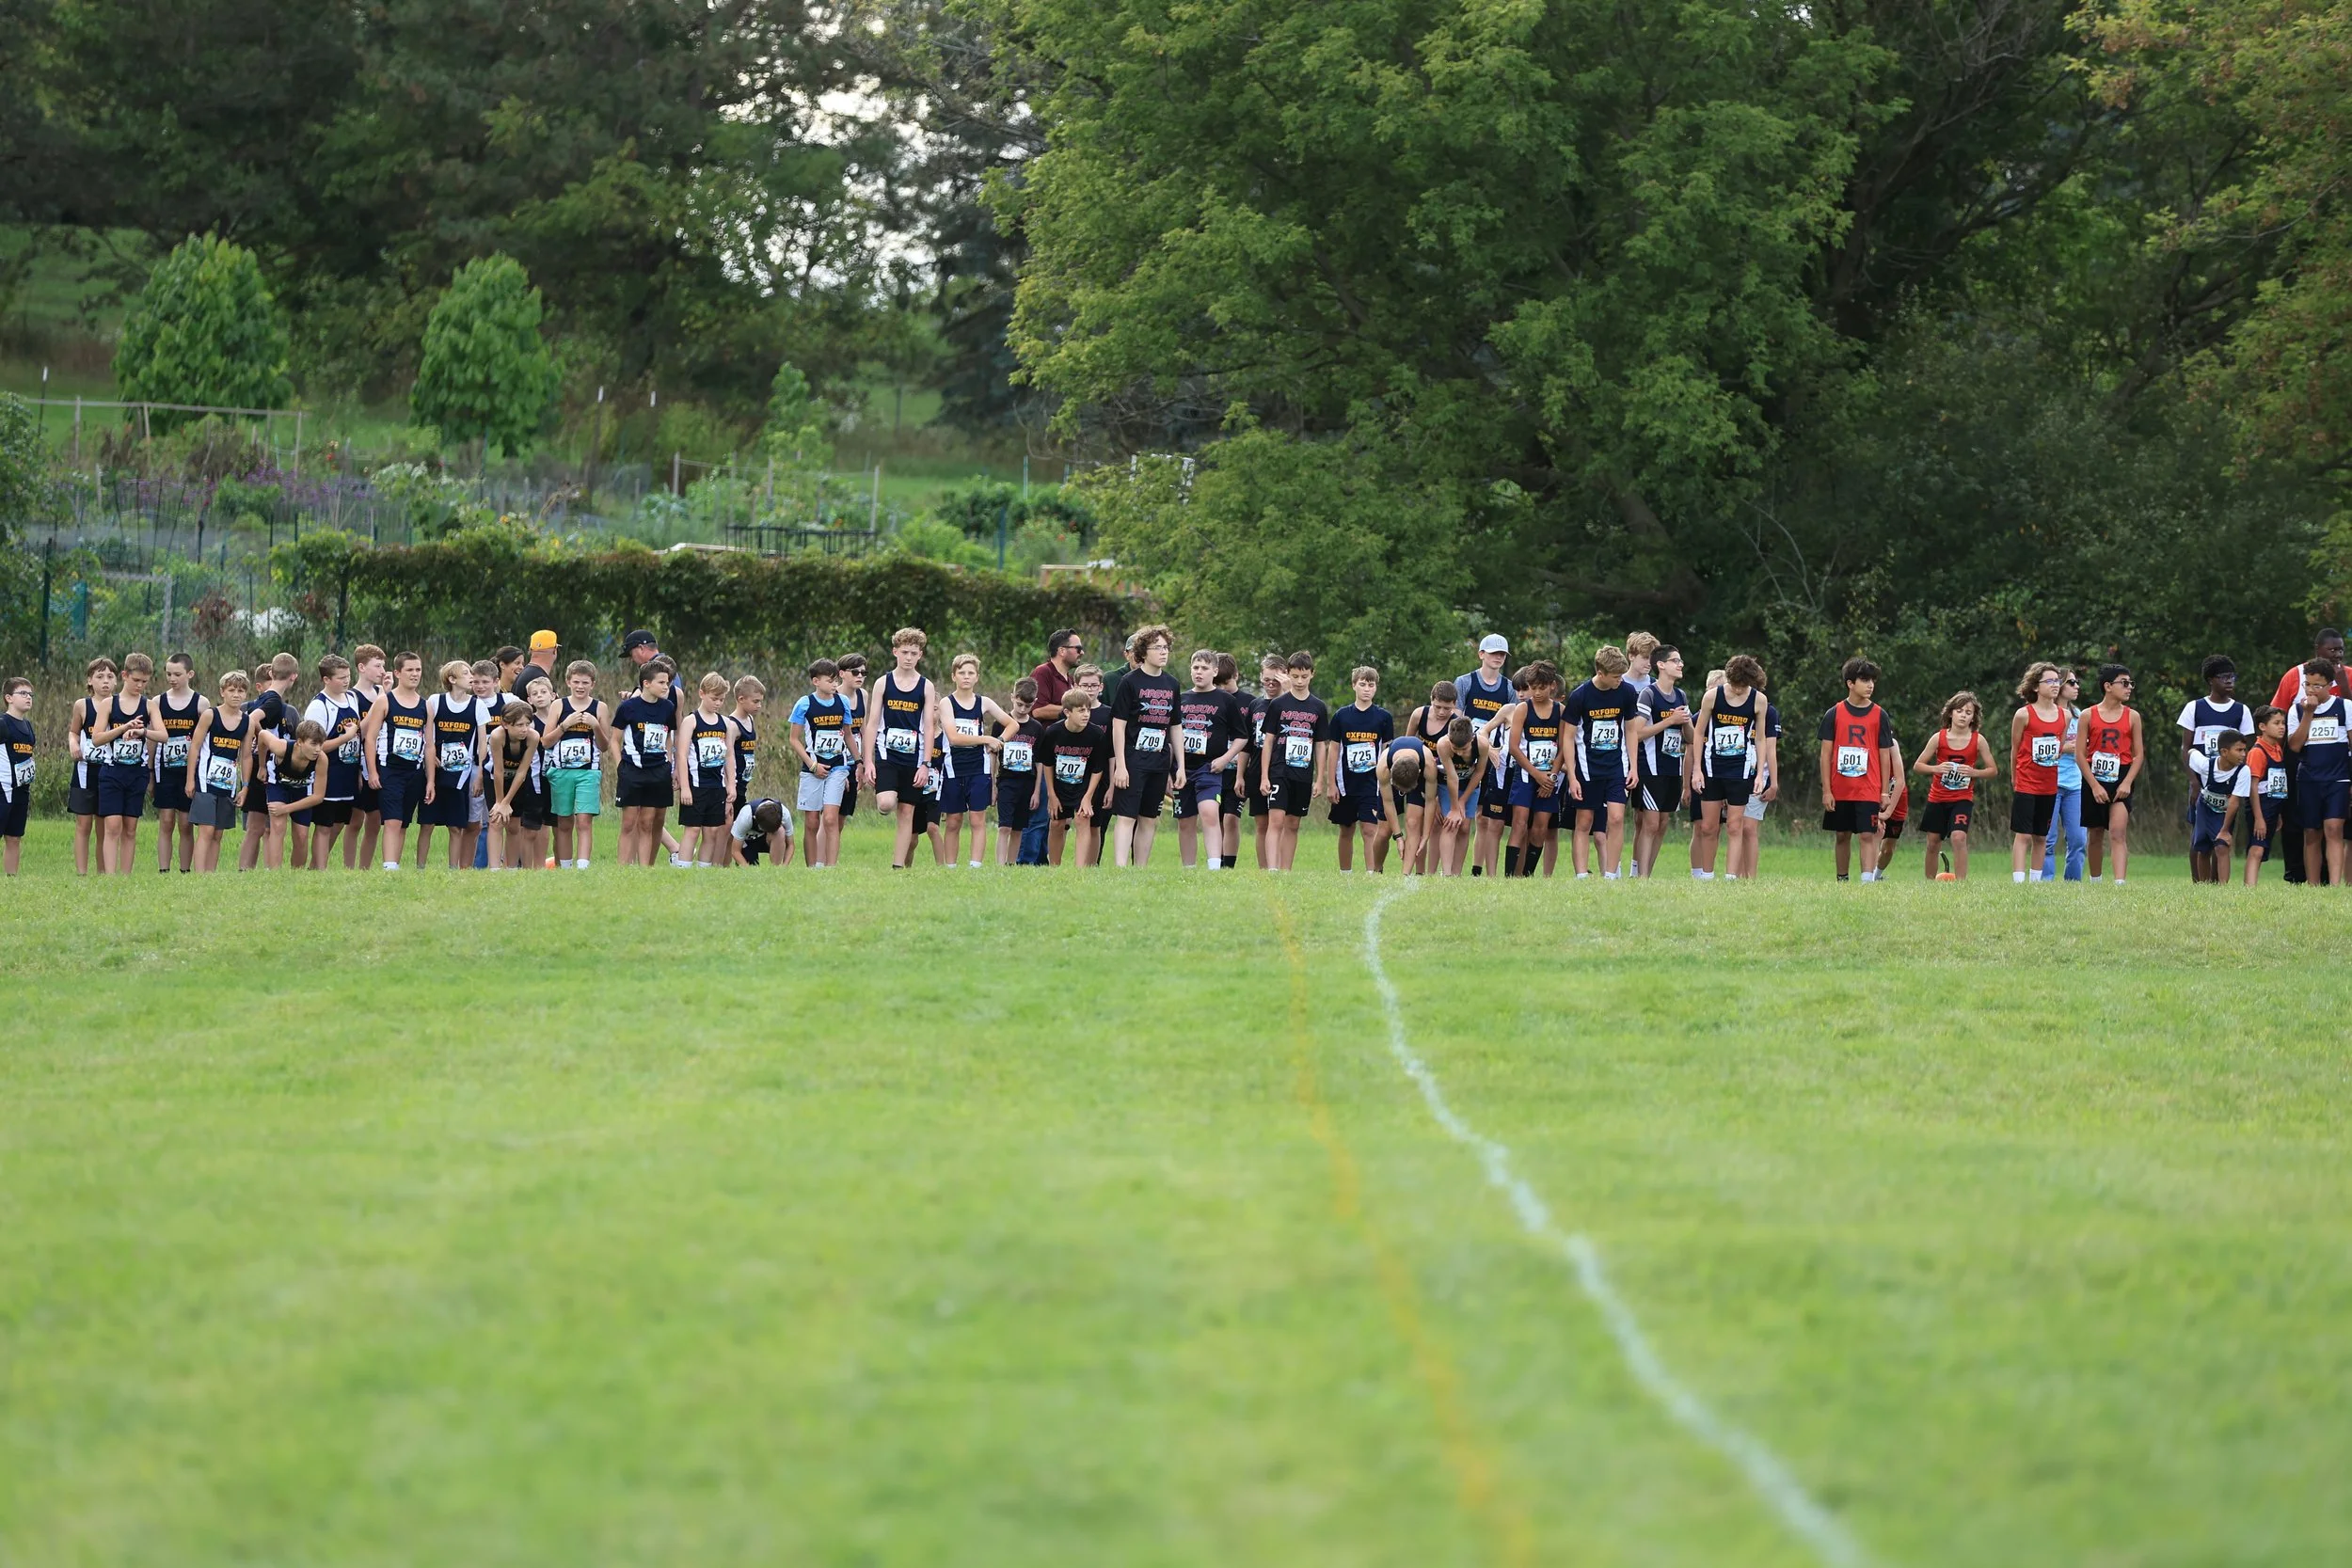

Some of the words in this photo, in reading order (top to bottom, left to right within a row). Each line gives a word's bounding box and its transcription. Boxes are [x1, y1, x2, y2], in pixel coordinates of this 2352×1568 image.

[1139, 689, 1173, 699] MASON
[887, 700, 919, 709] OXFORD
[1473, 699, 1502, 709] OXFORD
[1280, 711, 1318, 722] MASON
[1589, 708, 1620, 717] OXFORD
[393, 716, 423, 725] OXFORD
[1717, 714, 1748, 723] OXFORD
[438, 721, 470, 730] OXFORD
[956, 726, 974, 736] 756
[1597, 729, 1615, 739] 739
[1849, 724, 1867, 746] R
[2312, 727, 2335, 737] 2257
[214, 736, 241, 746] OXFORD
[399, 737, 418, 749] 759
[649, 732, 663, 744] 740
[819, 738, 838, 749] 747
[891, 736, 911, 747] 734
[1142, 736, 1160, 747] 709
[1184, 736, 1201, 749] 706
[1667, 736, 1679, 748] 729
[1721, 734, 1739, 745] 717
[2101, 728, 2121, 749] R
[88, 748, 103, 759] 72
[119, 744, 138, 754] 728
[168, 744, 187, 755] 764
[565, 746, 585, 757] 754
[1054, 745, 1092, 755] MASON
[1292, 745, 1309, 755] 708
[1535, 749, 1551, 759] 741
[2038, 744, 2057, 755] 605
[445, 749, 464, 764] 735
[1009, 750, 1028, 760] 705
[1353, 751, 1372, 762] 725
[1843, 754, 1862, 766] 601
[1061, 763, 1081, 773] 707
[2096, 758, 2115, 771] 603
[21, 766, 35, 781] 733
[216, 765, 233, 778] 748
[1955, 814, 1967, 825] R
